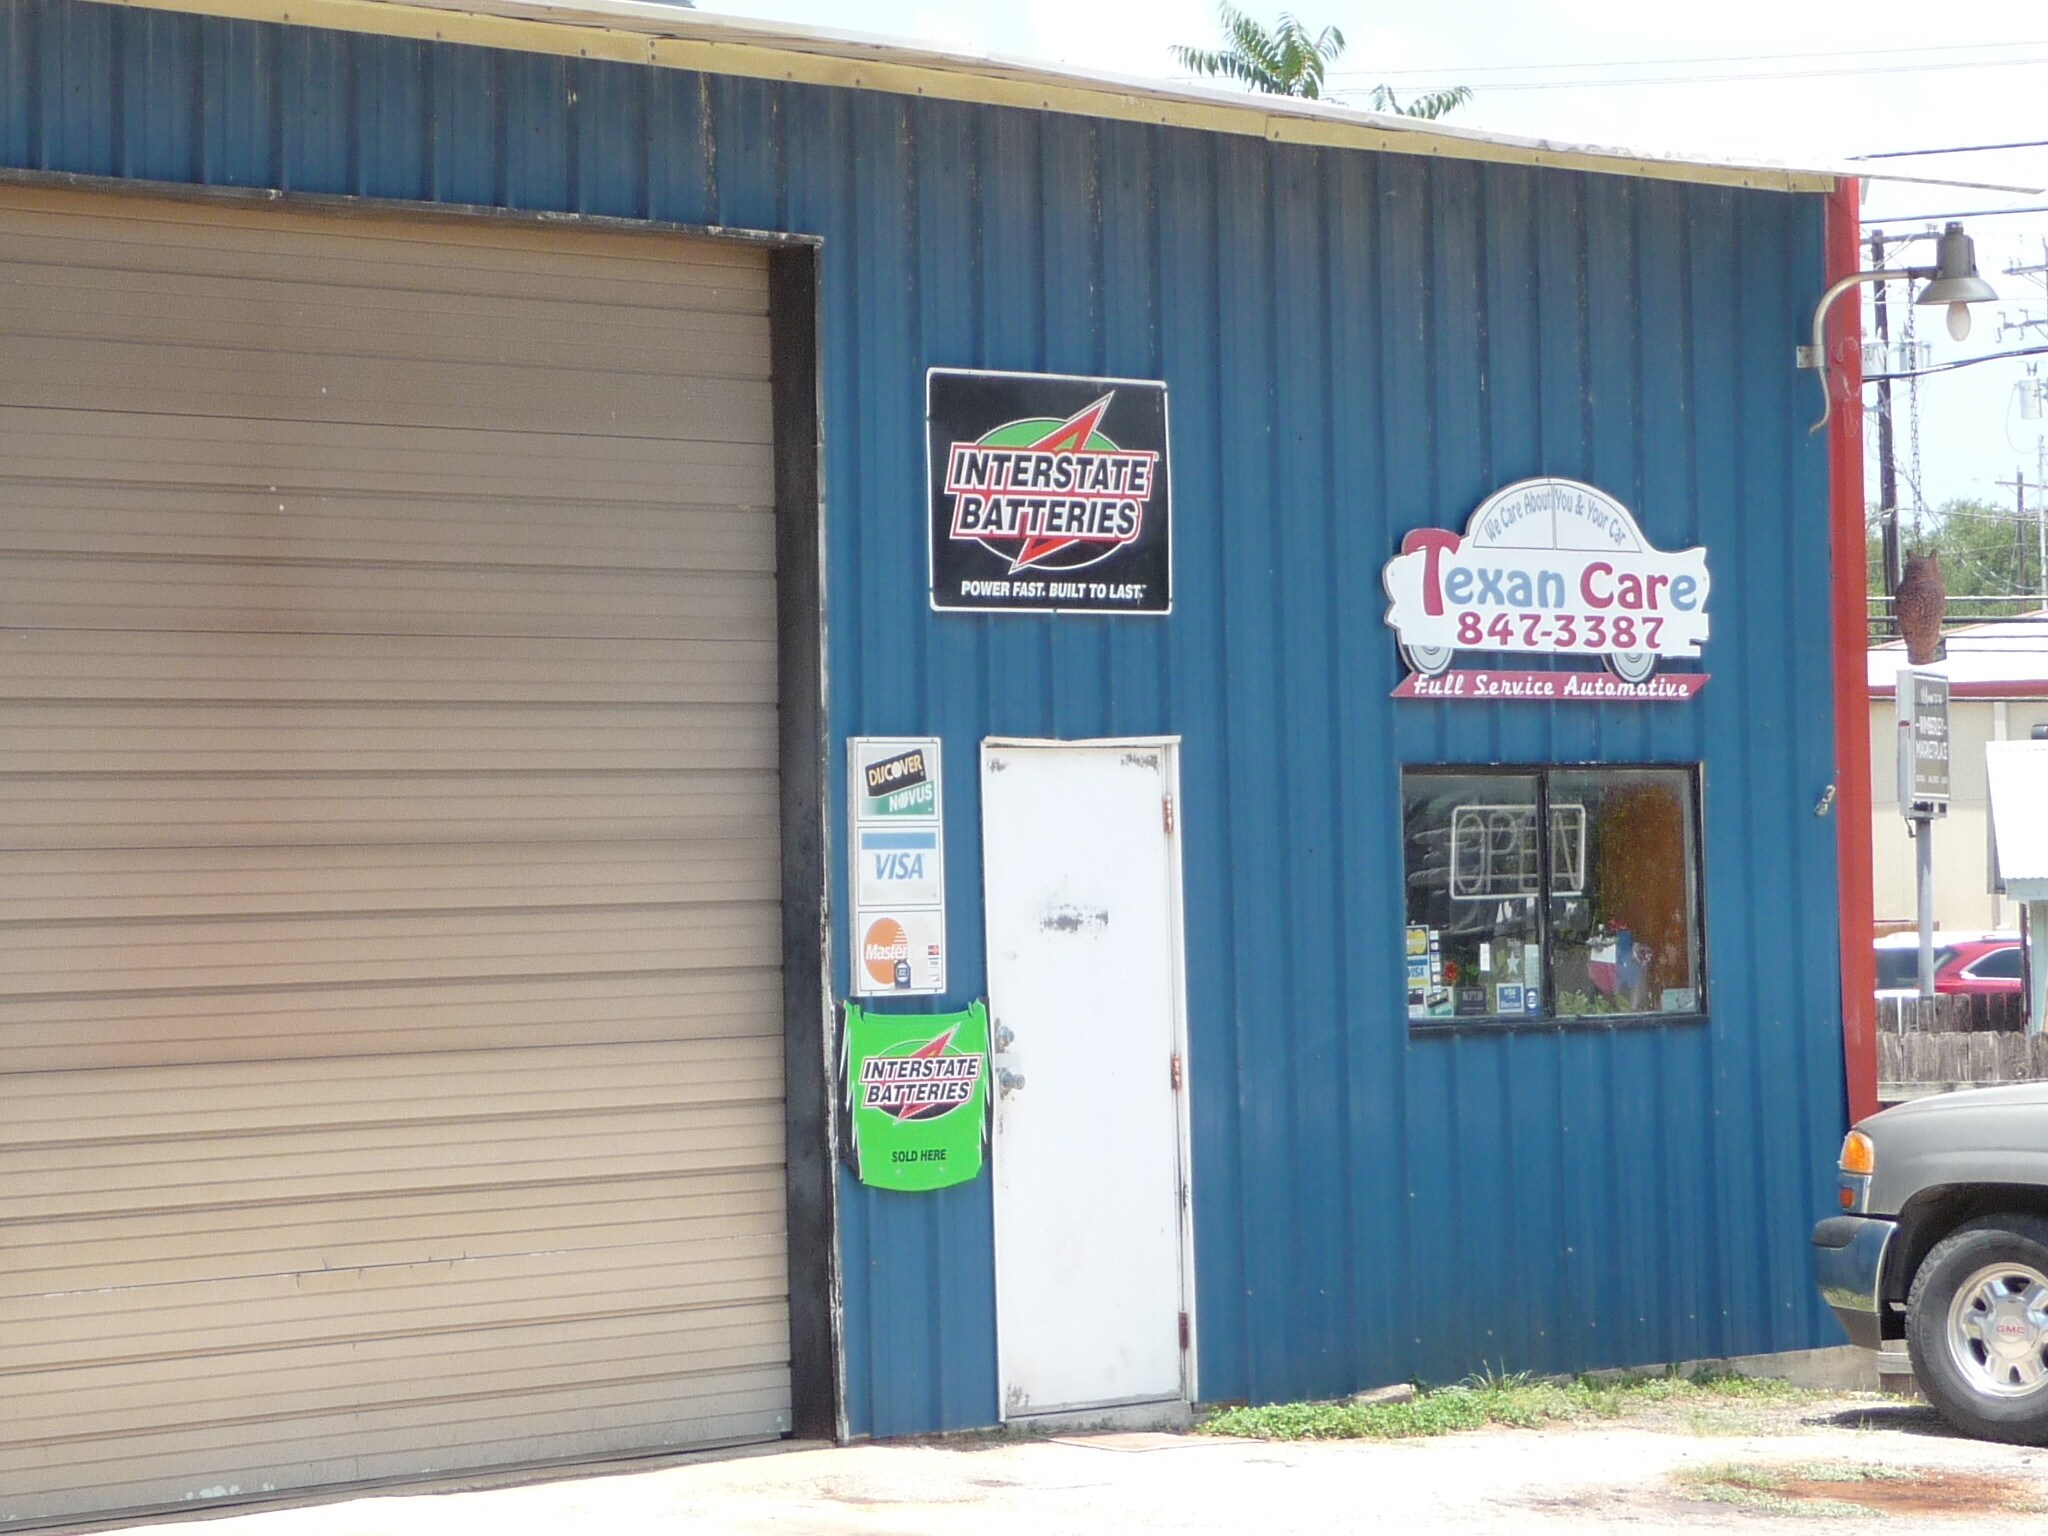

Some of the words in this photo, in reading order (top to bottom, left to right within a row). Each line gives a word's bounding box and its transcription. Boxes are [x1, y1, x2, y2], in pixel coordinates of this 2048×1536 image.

[952, 450, 1150, 493] INTERSTATE
[959, 499, 1138, 537] BATTERIES
[1484, 518, 1502, 542] We
[1500, 502, 1523, 528] Care
[1524, 490, 1551, 515] About
[1555, 489, 1573, 513] You
[1575, 494, 1584, 516] &
[1587, 499, 1609, 530] Your
[1609, 518, 1627, 546] Car
[1401, 528, 1566, 616] Texan
[1579, 561, 1698, 612] Care
[960, 580, 1010, 597] POWER
[1012, 582, 1046, 597] FAST.
[1049, 582, 1087, 598] BUILT
[1089, 584, 1107, 598] TO
[1456, 611, 1665, 650] 847-3387
[1413, 674, 1464, 696] Full
[1473, 674, 1556, 696] Service
[1563, 675, 1691, 698] Automotive
[868, 754, 923, 786] DISCOVER
[889, 783, 933, 812] NOVUS
[875, 853, 924, 880] VISA
[1456, 810, 1585, 895] OPEN
[863, 1057, 980, 1080] INTERSTATE
[867, 1081, 970, 1104] BATTERIES
[891, 1150, 918, 1163] SOLD
[920, 1149, 947, 1162] HERE
[1996, 1324, 2026, 1334] GMC
